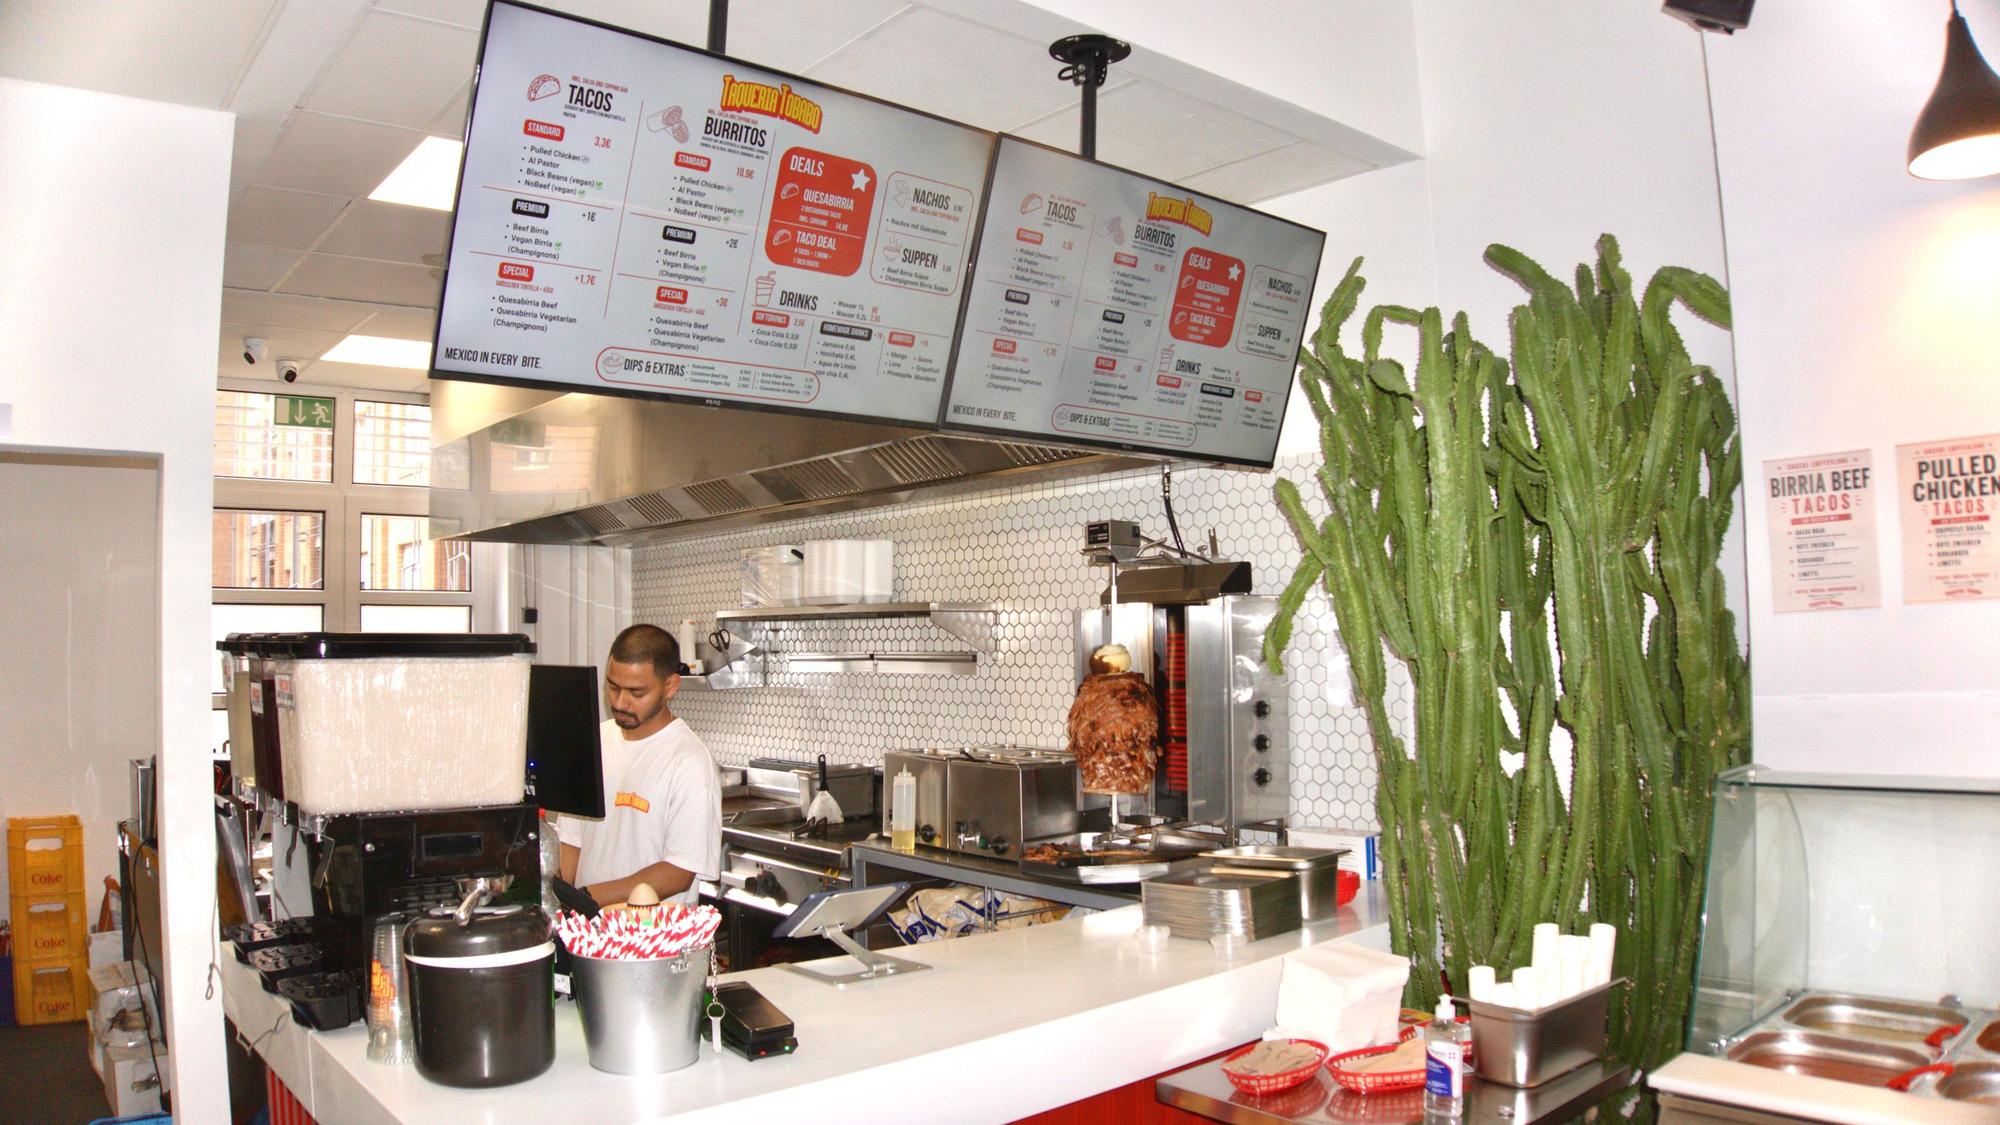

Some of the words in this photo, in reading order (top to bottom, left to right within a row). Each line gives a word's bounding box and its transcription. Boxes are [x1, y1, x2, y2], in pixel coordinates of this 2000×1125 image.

[569, 83, 613, 112] TACOS
[721, 75, 780, 113] TAQUERIA
[528, 122, 561, 137] STANDARD
[704, 116, 767, 148] BURRITOS
[530, 145, 552, 156] Pulled
[553, 150, 581, 161] Chicken
[679, 154, 707, 168] STANDARD
[528, 157, 536, 165] Al
[537, 158, 560, 169] Pastor
[789, 155, 825, 177] DEALS
[526, 168, 545, 178] Black
[547, 171, 568, 182] Beans
[569, 176, 595, 187] (vegan)
[680, 175, 700, 186] Pulled
[700, 180, 725, 192] Chicken
[524, 179, 550, 190] NoBeef
[551, 184, 577, 196] (vegan)
[677, 186, 685, 194] Al
[686, 188, 707, 198] Pastor
[676, 197, 693, 207] Black
[694, 200, 713, 210] Beans
[714, 204, 737, 216] (vegan)
[803, 188, 855, 212] QUESABIRRIA
[912, 188, 951, 210] NACHOS
[515, 201, 547, 216] PREMIUM
[674, 207, 698, 217] NoBeef
[699, 211, 721, 223] (vegan)
[1046, 201, 1077, 222] TACOS
[512, 223, 529, 234] Beef
[530, 226, 550, 236] Birria
[891, 218, 910, 229] Nachos
[666, 227, 693, 240] PREMIUM
[796, 231, 817, 246] TACO
[817, 235, 837, 251] DEAL
[1134, 224, 1176, 248] BURRITOS
[511, 235, 532, 247] Vegan
[534, 238, 553, 249] Birria
[507, 245, 560, 261] (Champignons)
[663, 249, 679, 258] Beef
[679, 251, 696, 261] Birria
[901, 248, 938, 269] SUPPEN
[662, 260, 682, 270] Vegan
[682, 262, 700, 272] Birria
[1188, 253, 1212, 270] DEALS
[502, 265, 530, 278] SPECIAL
[658, 269, 706, 284] (Champignons)
[1267, 277, 1294, 295] NACHOS
[498, 295, 540, 308] Quesabirria
[541, 300, 558, 310] Beef
[659, 288, 684, 301] SPECIAL
[779, 290, 819, 311] DRINKS
[496, 307, 538, 319] Quesabirria
[539, 312, 577, 324] Vegetarian
[655, 316, 692, 328] Quesabirria
[694, 321, 709, 330] Beef
[492, 318, 548, 333] (Champignons)
[756, 328, 771, 337] Coca
[771, 330, 785, 339] Cola
[1257, 325, 1282, 341] SUPPEN
[653, 328, 690, 339] Quesabirria
[691, 332, 725, 344] Vegetarian
[754, 338, 769, 347] Coca
[769, 340, 783, 349] Cola
[650, 338, 699, 352] (Champignons)
[444, 347, 479, 363] MEXICO
[479, 351, 489, 364] IN
[490, 352, 518, 367] EVERY
[521, 355, 543, 370] BITE.
[624, 358, 643, 373] DIPS
[644, 362, 651, 373] &
[652, 361, 686, 377] EXTRAS
[1175, 359, 1202, 375] DRINKS
[953, 404, 975, 417] MEXICO
[975, 408, 982, 417] IN
[982, 409, 1001, 419] EVERY
[1069, 412, 1083, 424] DIPS
[1088, 415, 1111, 427] EXTRAS
[1917, 454, 1996, 481] PULLED
[1770, 472, 1827, 498] BIRRIA
[1831, 467, 1871, 492] BEEF
[1913, 475, 2000, 502] CHICKEN
[1791, 492, 1851, 515] TACOS
[1933, 498, 1985, 516] TACOS
[31, 871, 63, 885] Coke
[34, 936, 67, 950] Coke
[38, 999, 70, 1013] Coke
